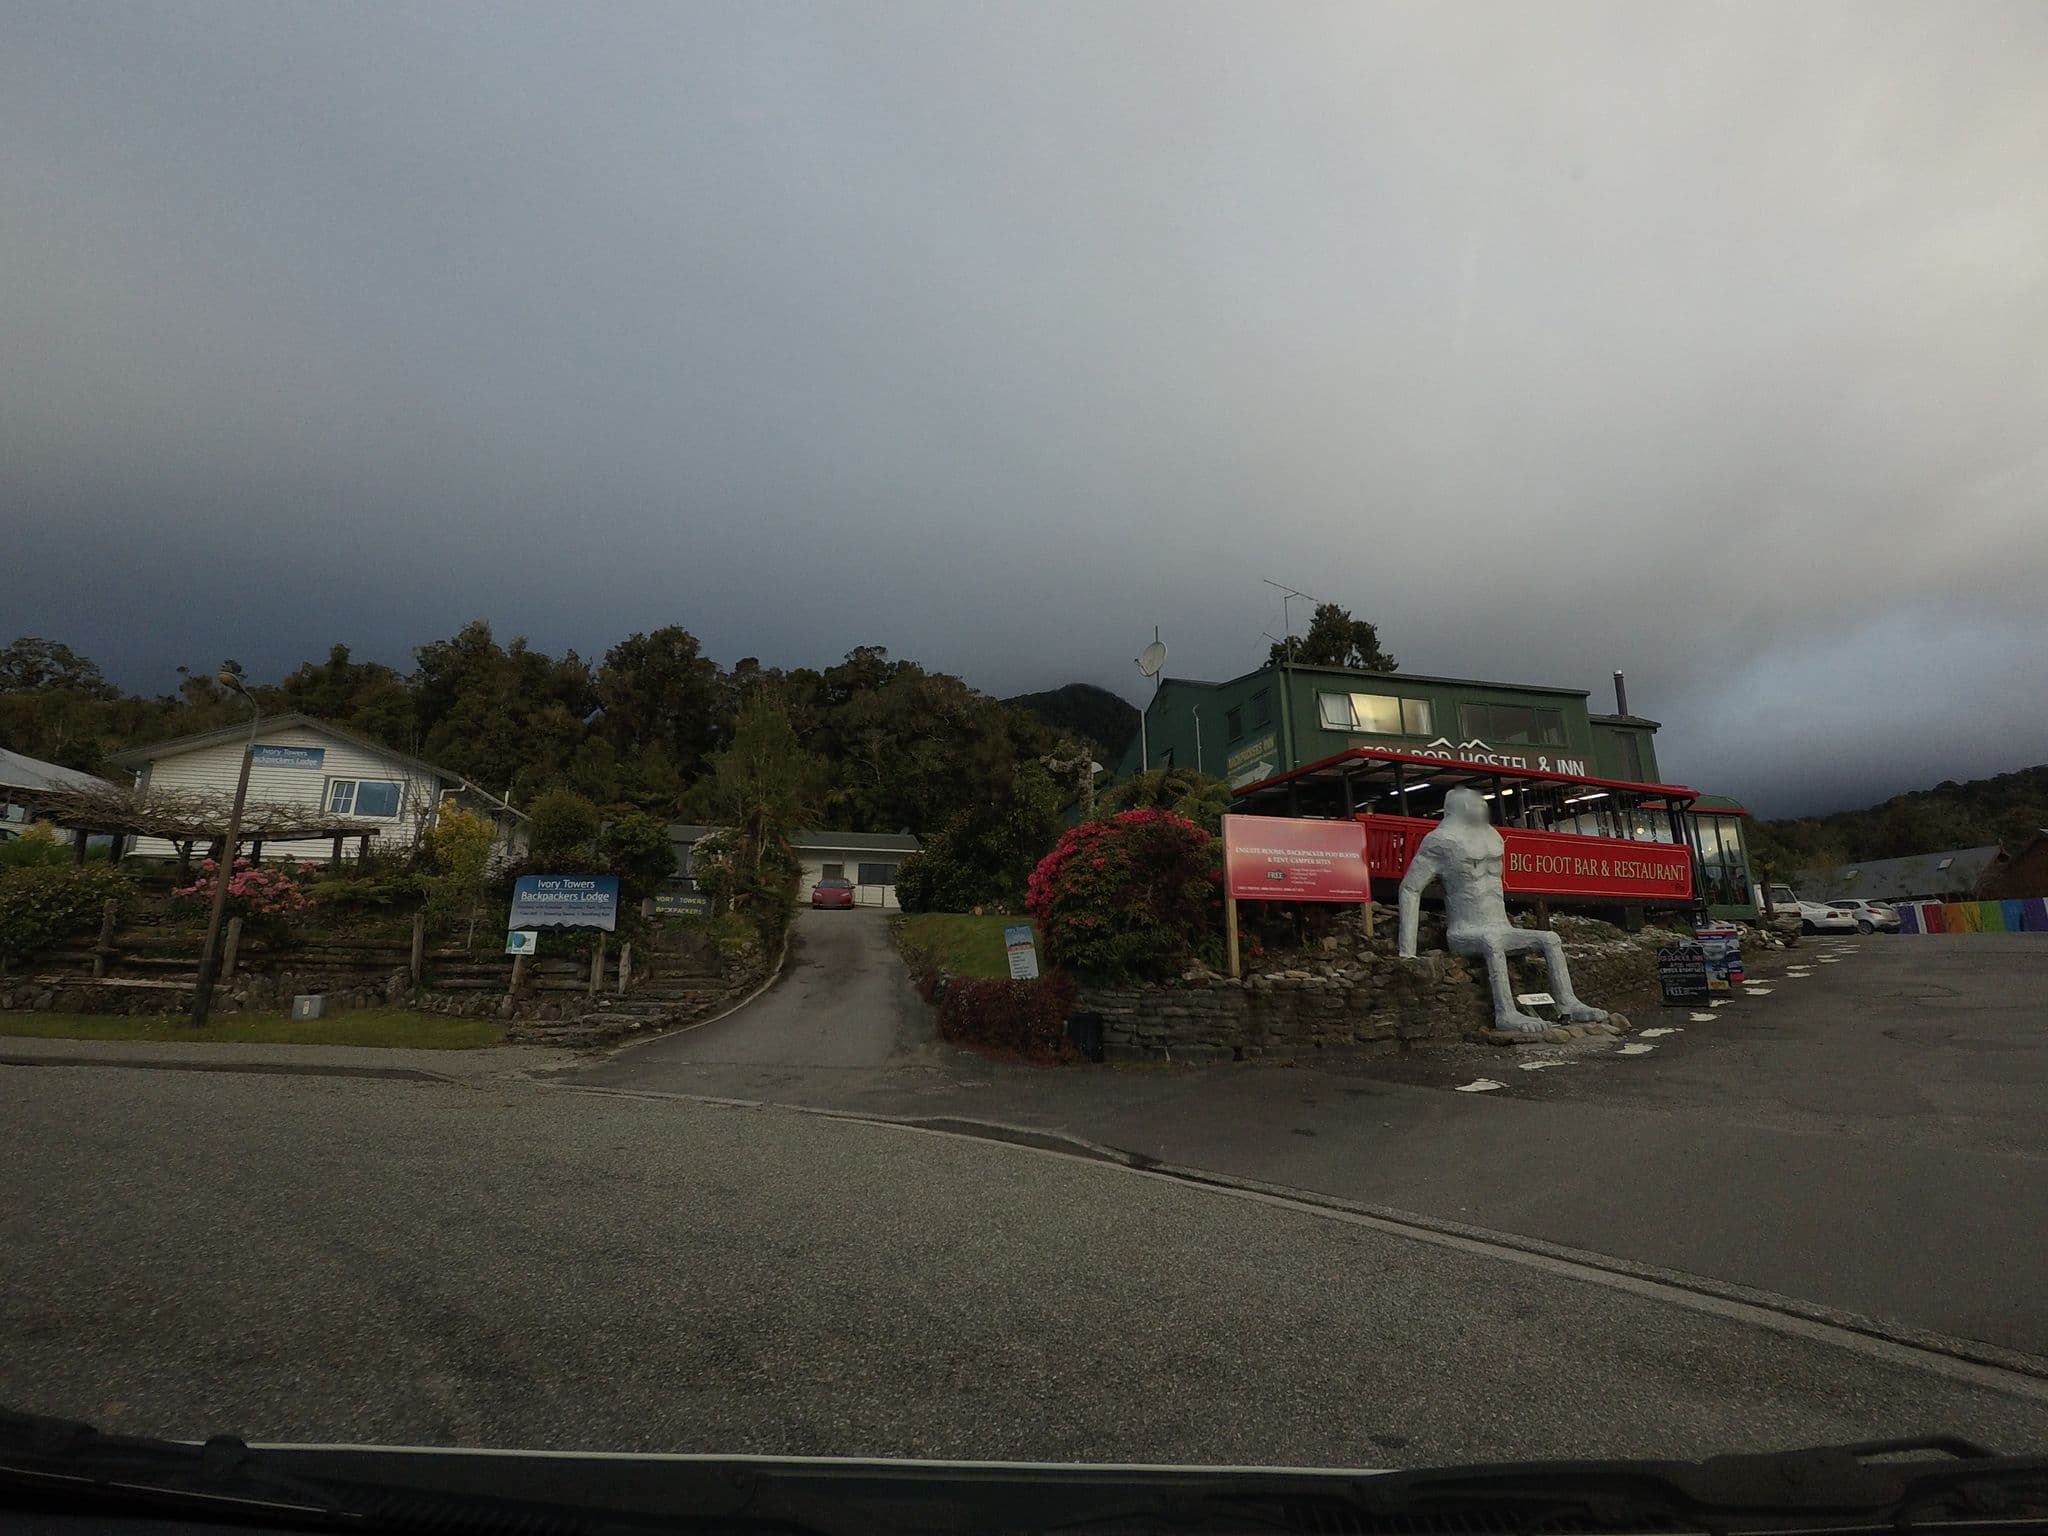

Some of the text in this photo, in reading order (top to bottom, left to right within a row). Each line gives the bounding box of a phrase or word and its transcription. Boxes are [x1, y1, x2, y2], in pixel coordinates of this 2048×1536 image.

[1556, 759, 1585, 777] INN
[1509, 853, 1685, 881] BIG FOOT BAR & RESTAURANT
[1267, 871, 1284, 880] FREE
[537, 879, 595, 890] Ivory Towers
[521, 891, 610, 903] Backpackers Lodge
